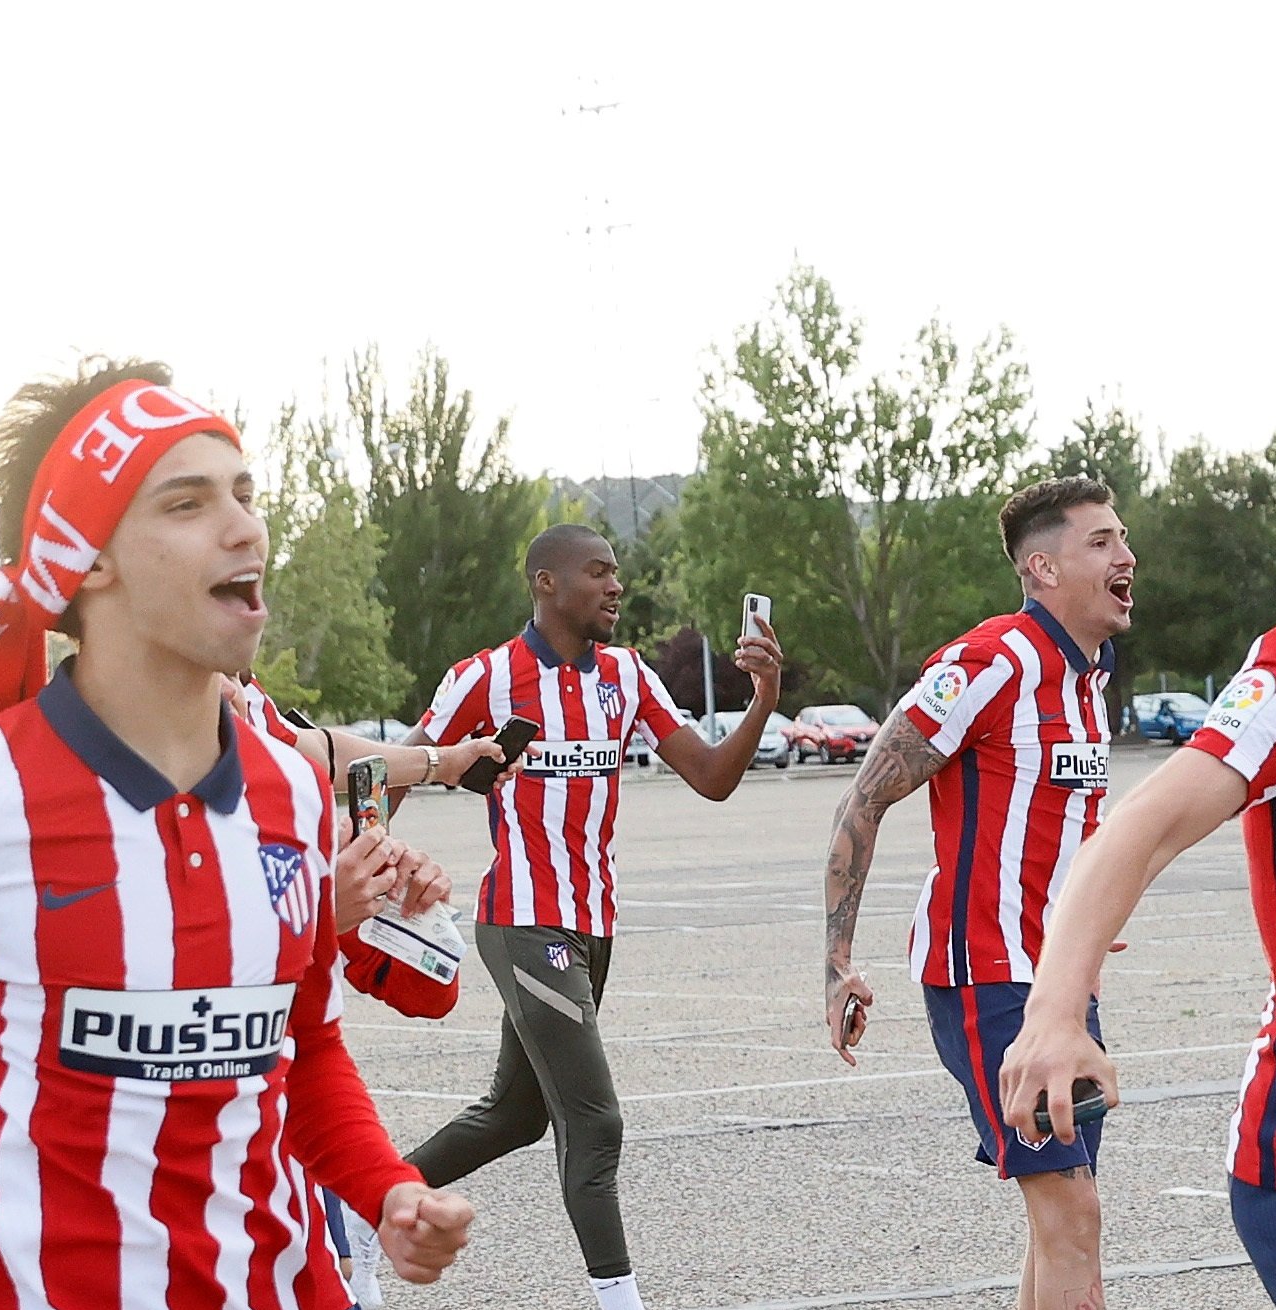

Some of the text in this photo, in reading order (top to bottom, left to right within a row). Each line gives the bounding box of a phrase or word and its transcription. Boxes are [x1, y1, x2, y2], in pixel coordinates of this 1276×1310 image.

[71, 385, 213, 485] DE
[922, 691, 948, 716] LaLiga
[526, 750, 617, 767] Plus500
[71, 1008, 287, 1055] Plus500
[142, 1061, 251, 1080] Trade Online
